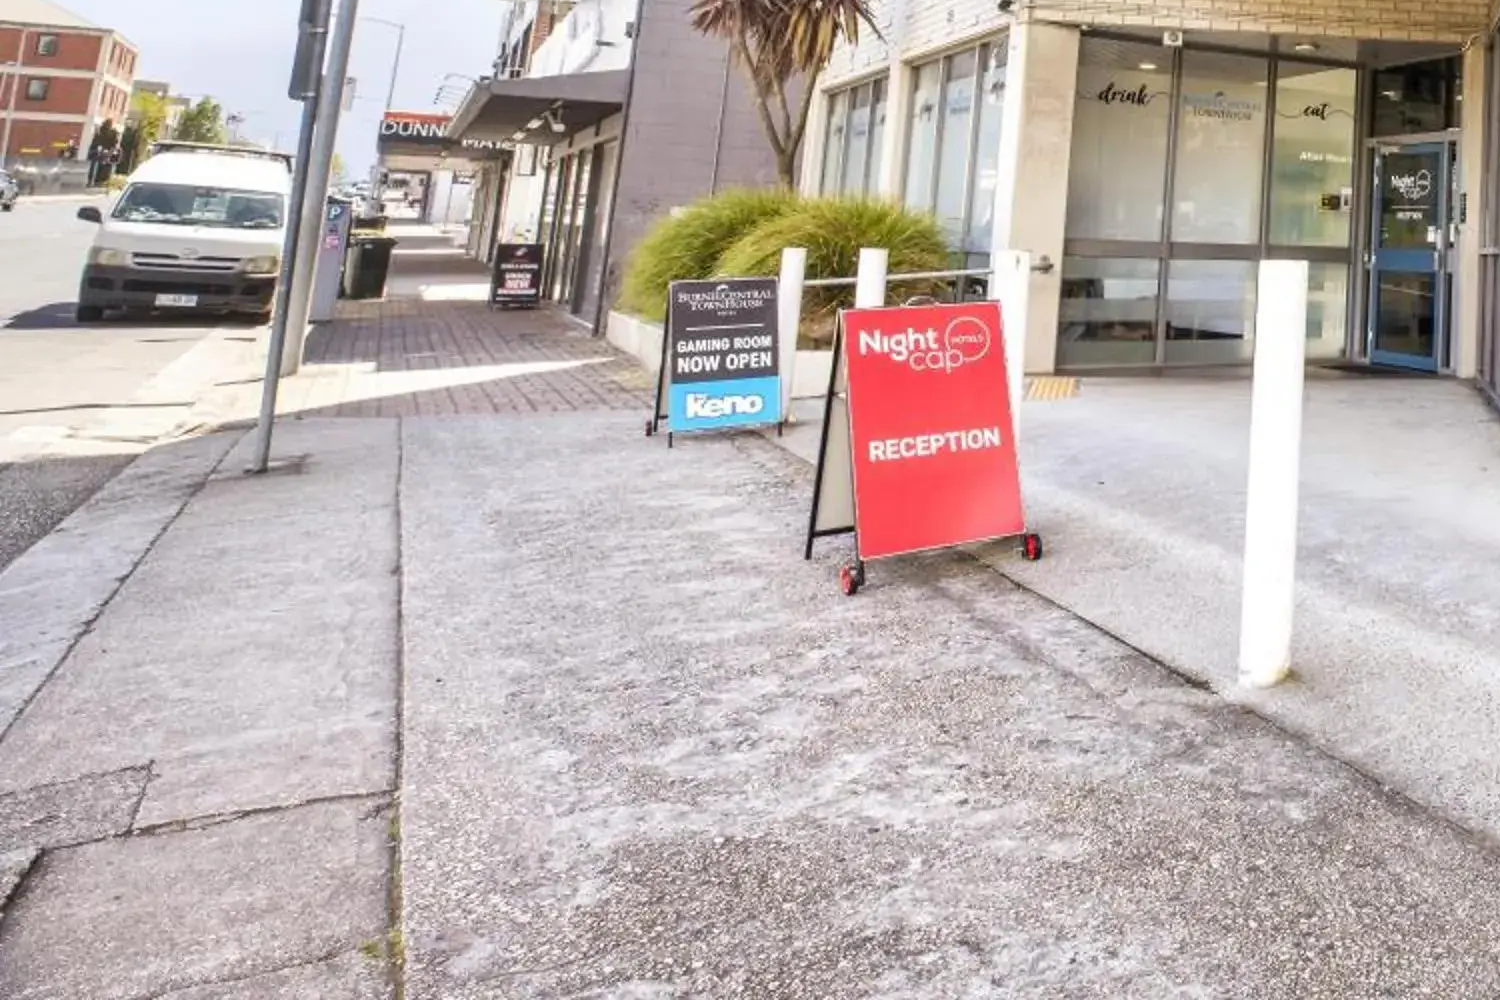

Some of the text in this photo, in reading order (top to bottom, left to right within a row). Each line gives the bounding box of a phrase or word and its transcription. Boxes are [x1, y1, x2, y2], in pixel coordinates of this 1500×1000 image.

[1098, 82, 1148, 105] drink
[677, 335, 772, 353] GAMING ROOM
[859, 327, 939, 361] Night
[677, 351, 772, 374] NOW OPEN
[868, 426, 1001, 463] RECEPTION
